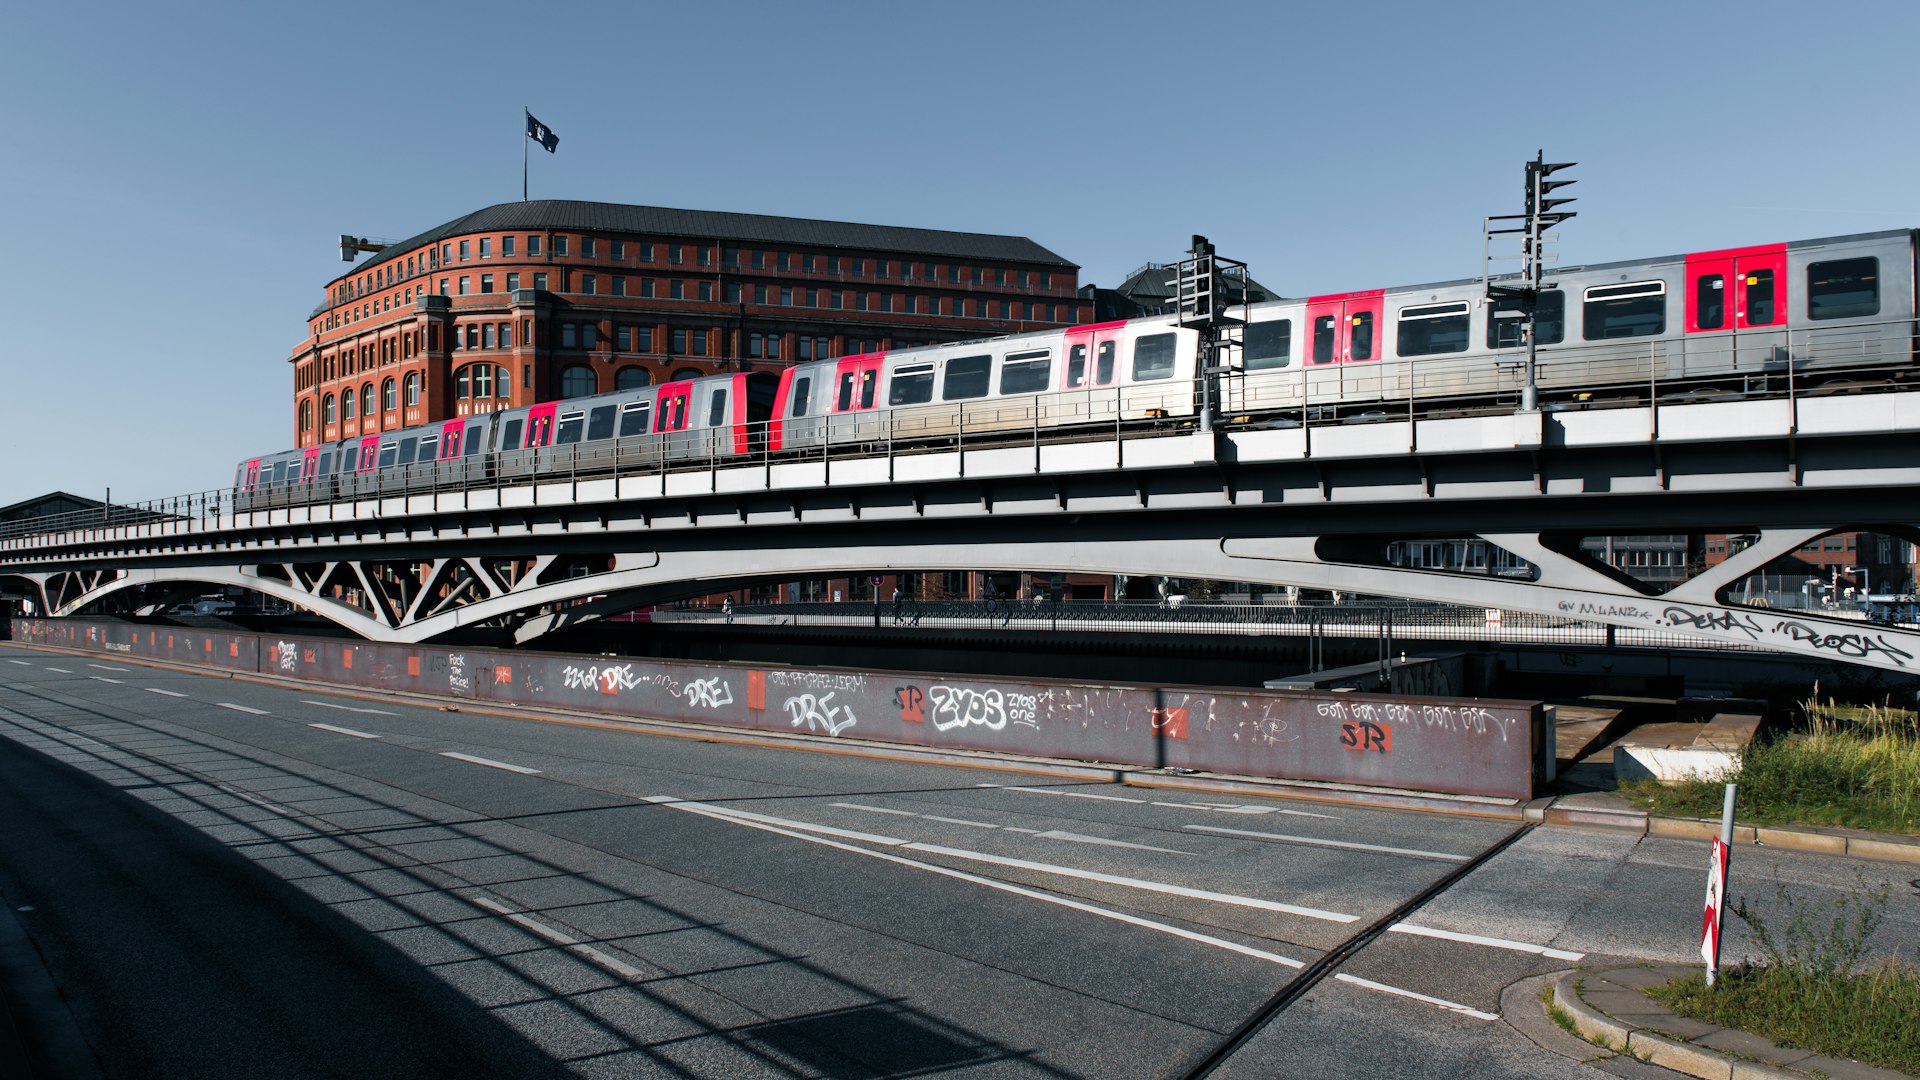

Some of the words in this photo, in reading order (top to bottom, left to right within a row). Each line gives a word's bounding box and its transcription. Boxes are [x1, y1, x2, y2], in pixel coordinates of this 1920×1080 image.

[449, 653, 466, 667] Fuck
[450, 666, 463, 677] The
[601, 663, 642, 691] DRE
[683, 676, 734, 709] DRE
[1006, 692, 1037, 711] ZYOS
[782, 691, 857, 737] DRE
[929, 685, 1007, 732] ZYOS
